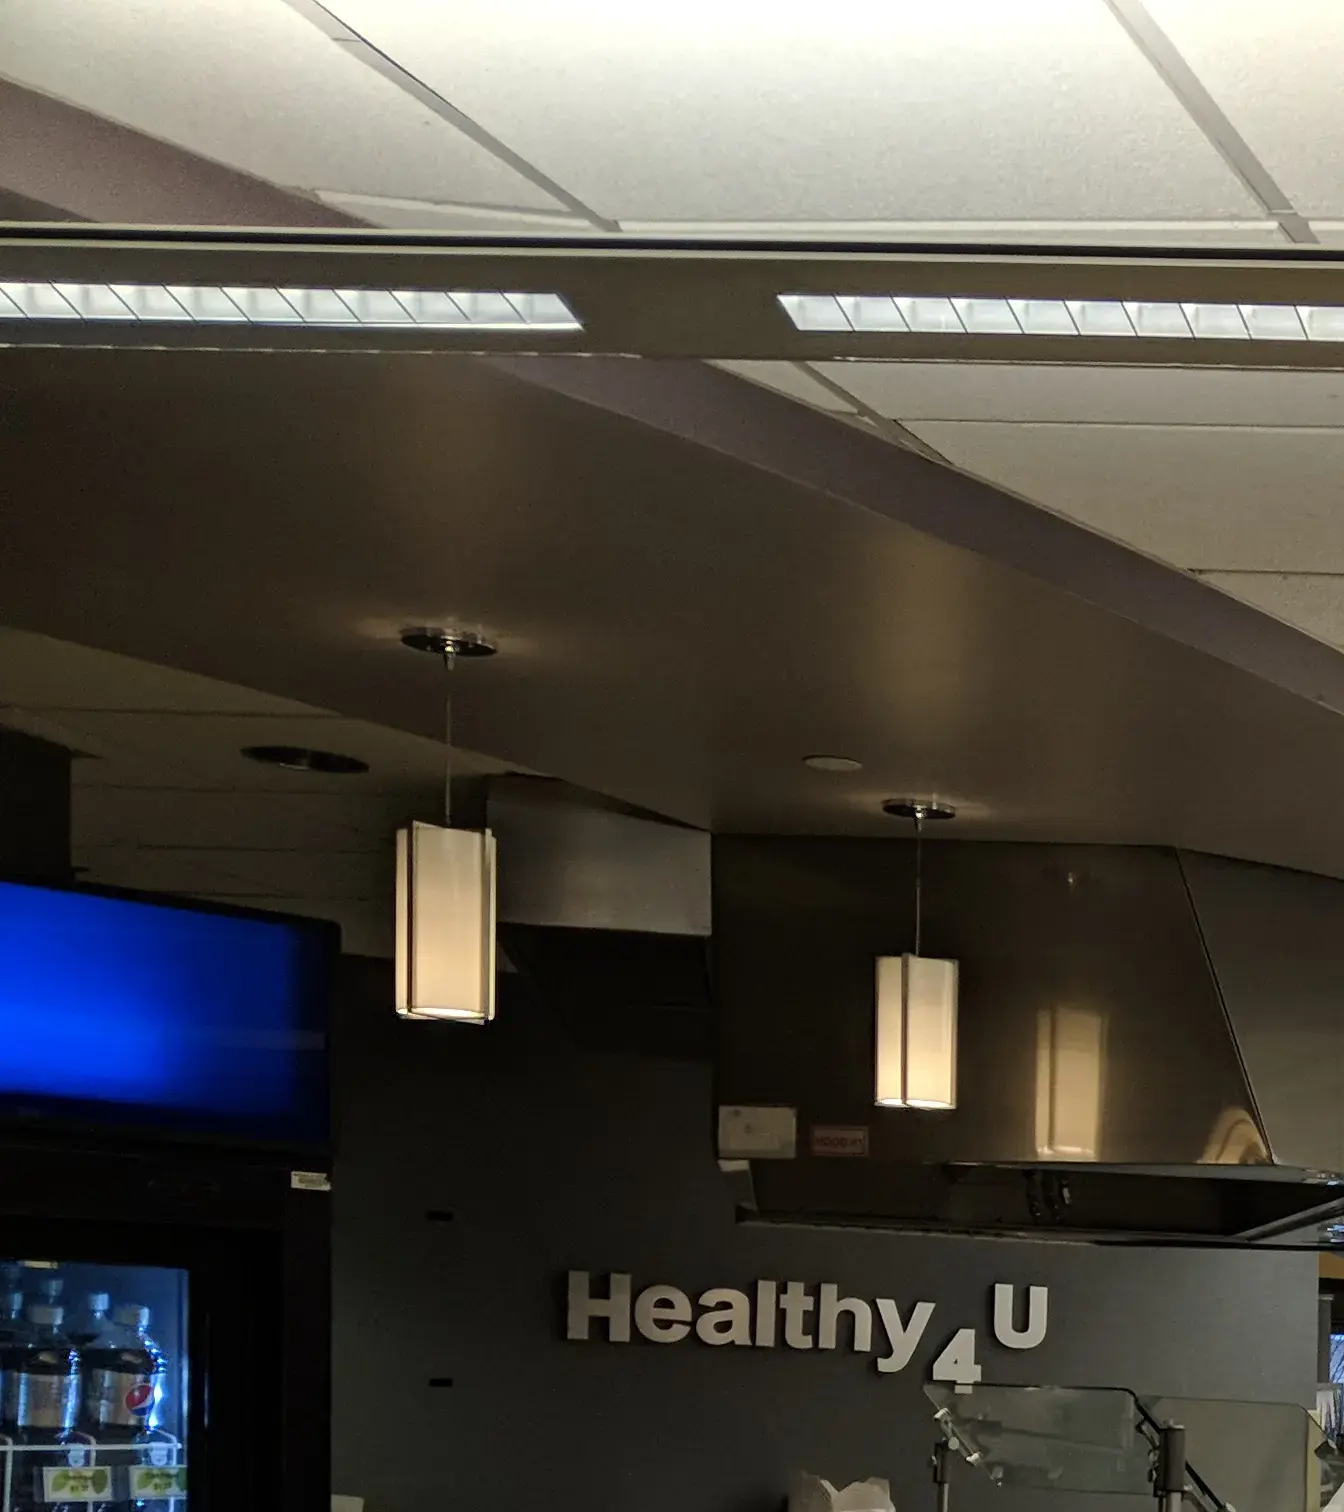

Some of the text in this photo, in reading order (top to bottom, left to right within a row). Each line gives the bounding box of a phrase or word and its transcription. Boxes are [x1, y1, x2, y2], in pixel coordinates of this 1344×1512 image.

[566, 1270, 1049, 1395] Healthy 4 U
